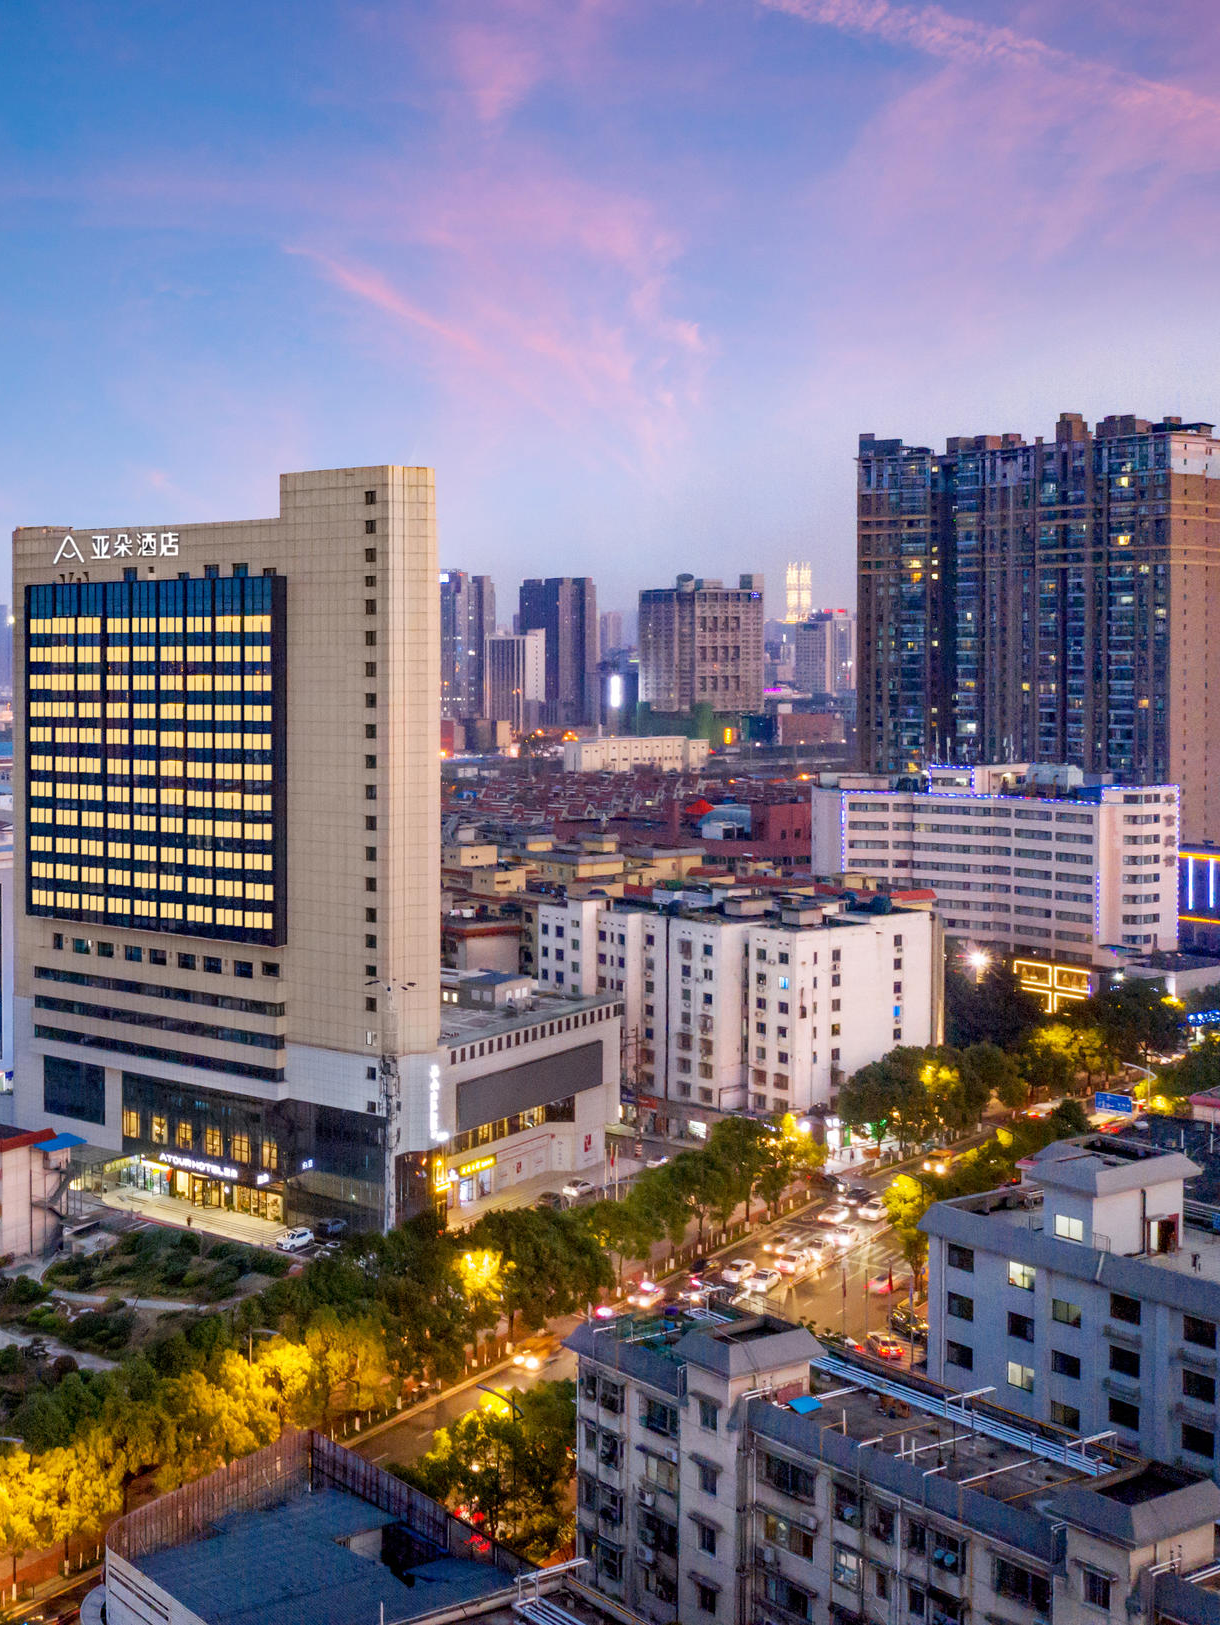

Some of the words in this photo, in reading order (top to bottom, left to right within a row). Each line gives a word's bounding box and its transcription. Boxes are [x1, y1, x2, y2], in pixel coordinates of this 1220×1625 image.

[90, 531, 180, 560] 亚朵酒店
[159, 1152, 191, 1168] ATOUR
[192, 1160, 223, 1176] HOTEL
